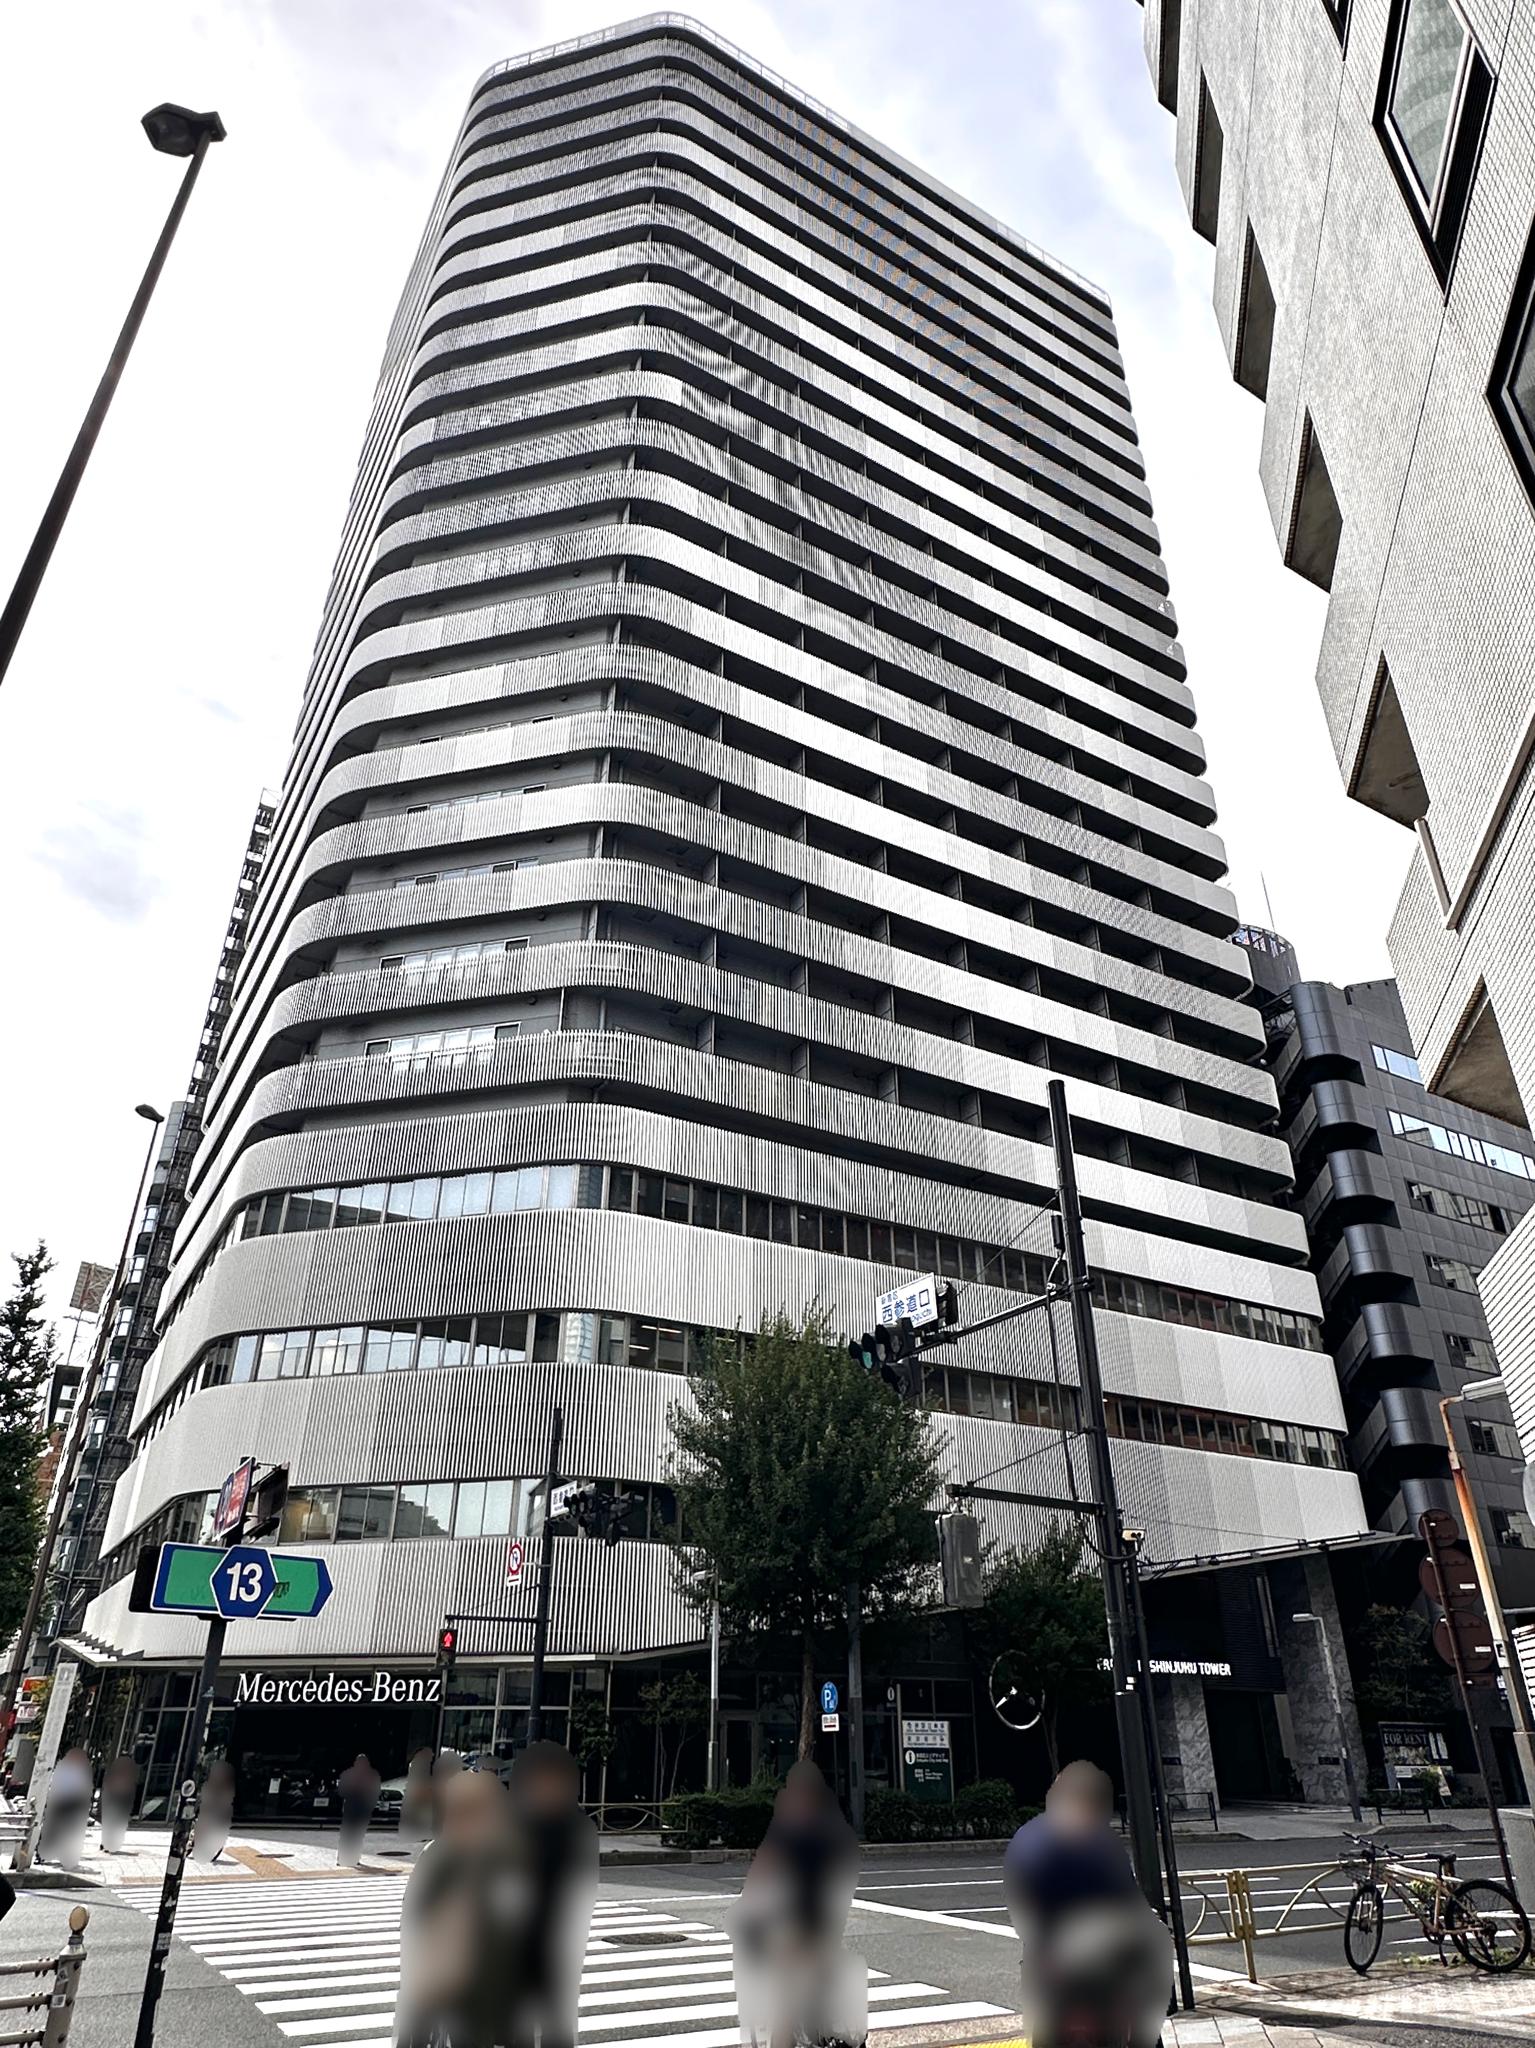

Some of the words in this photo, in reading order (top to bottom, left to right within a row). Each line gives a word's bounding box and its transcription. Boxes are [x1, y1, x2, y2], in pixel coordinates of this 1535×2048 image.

[882, 1289, 930, 1323] 西参道口
[226, 1562, 263, 1602] 13
[1149, 1659, 1197, 1674] SHINJUKU
[1198, 1662, 1232, 1676] TOWER
[233, 1671, 441, 1703] Mercedes-Benz
